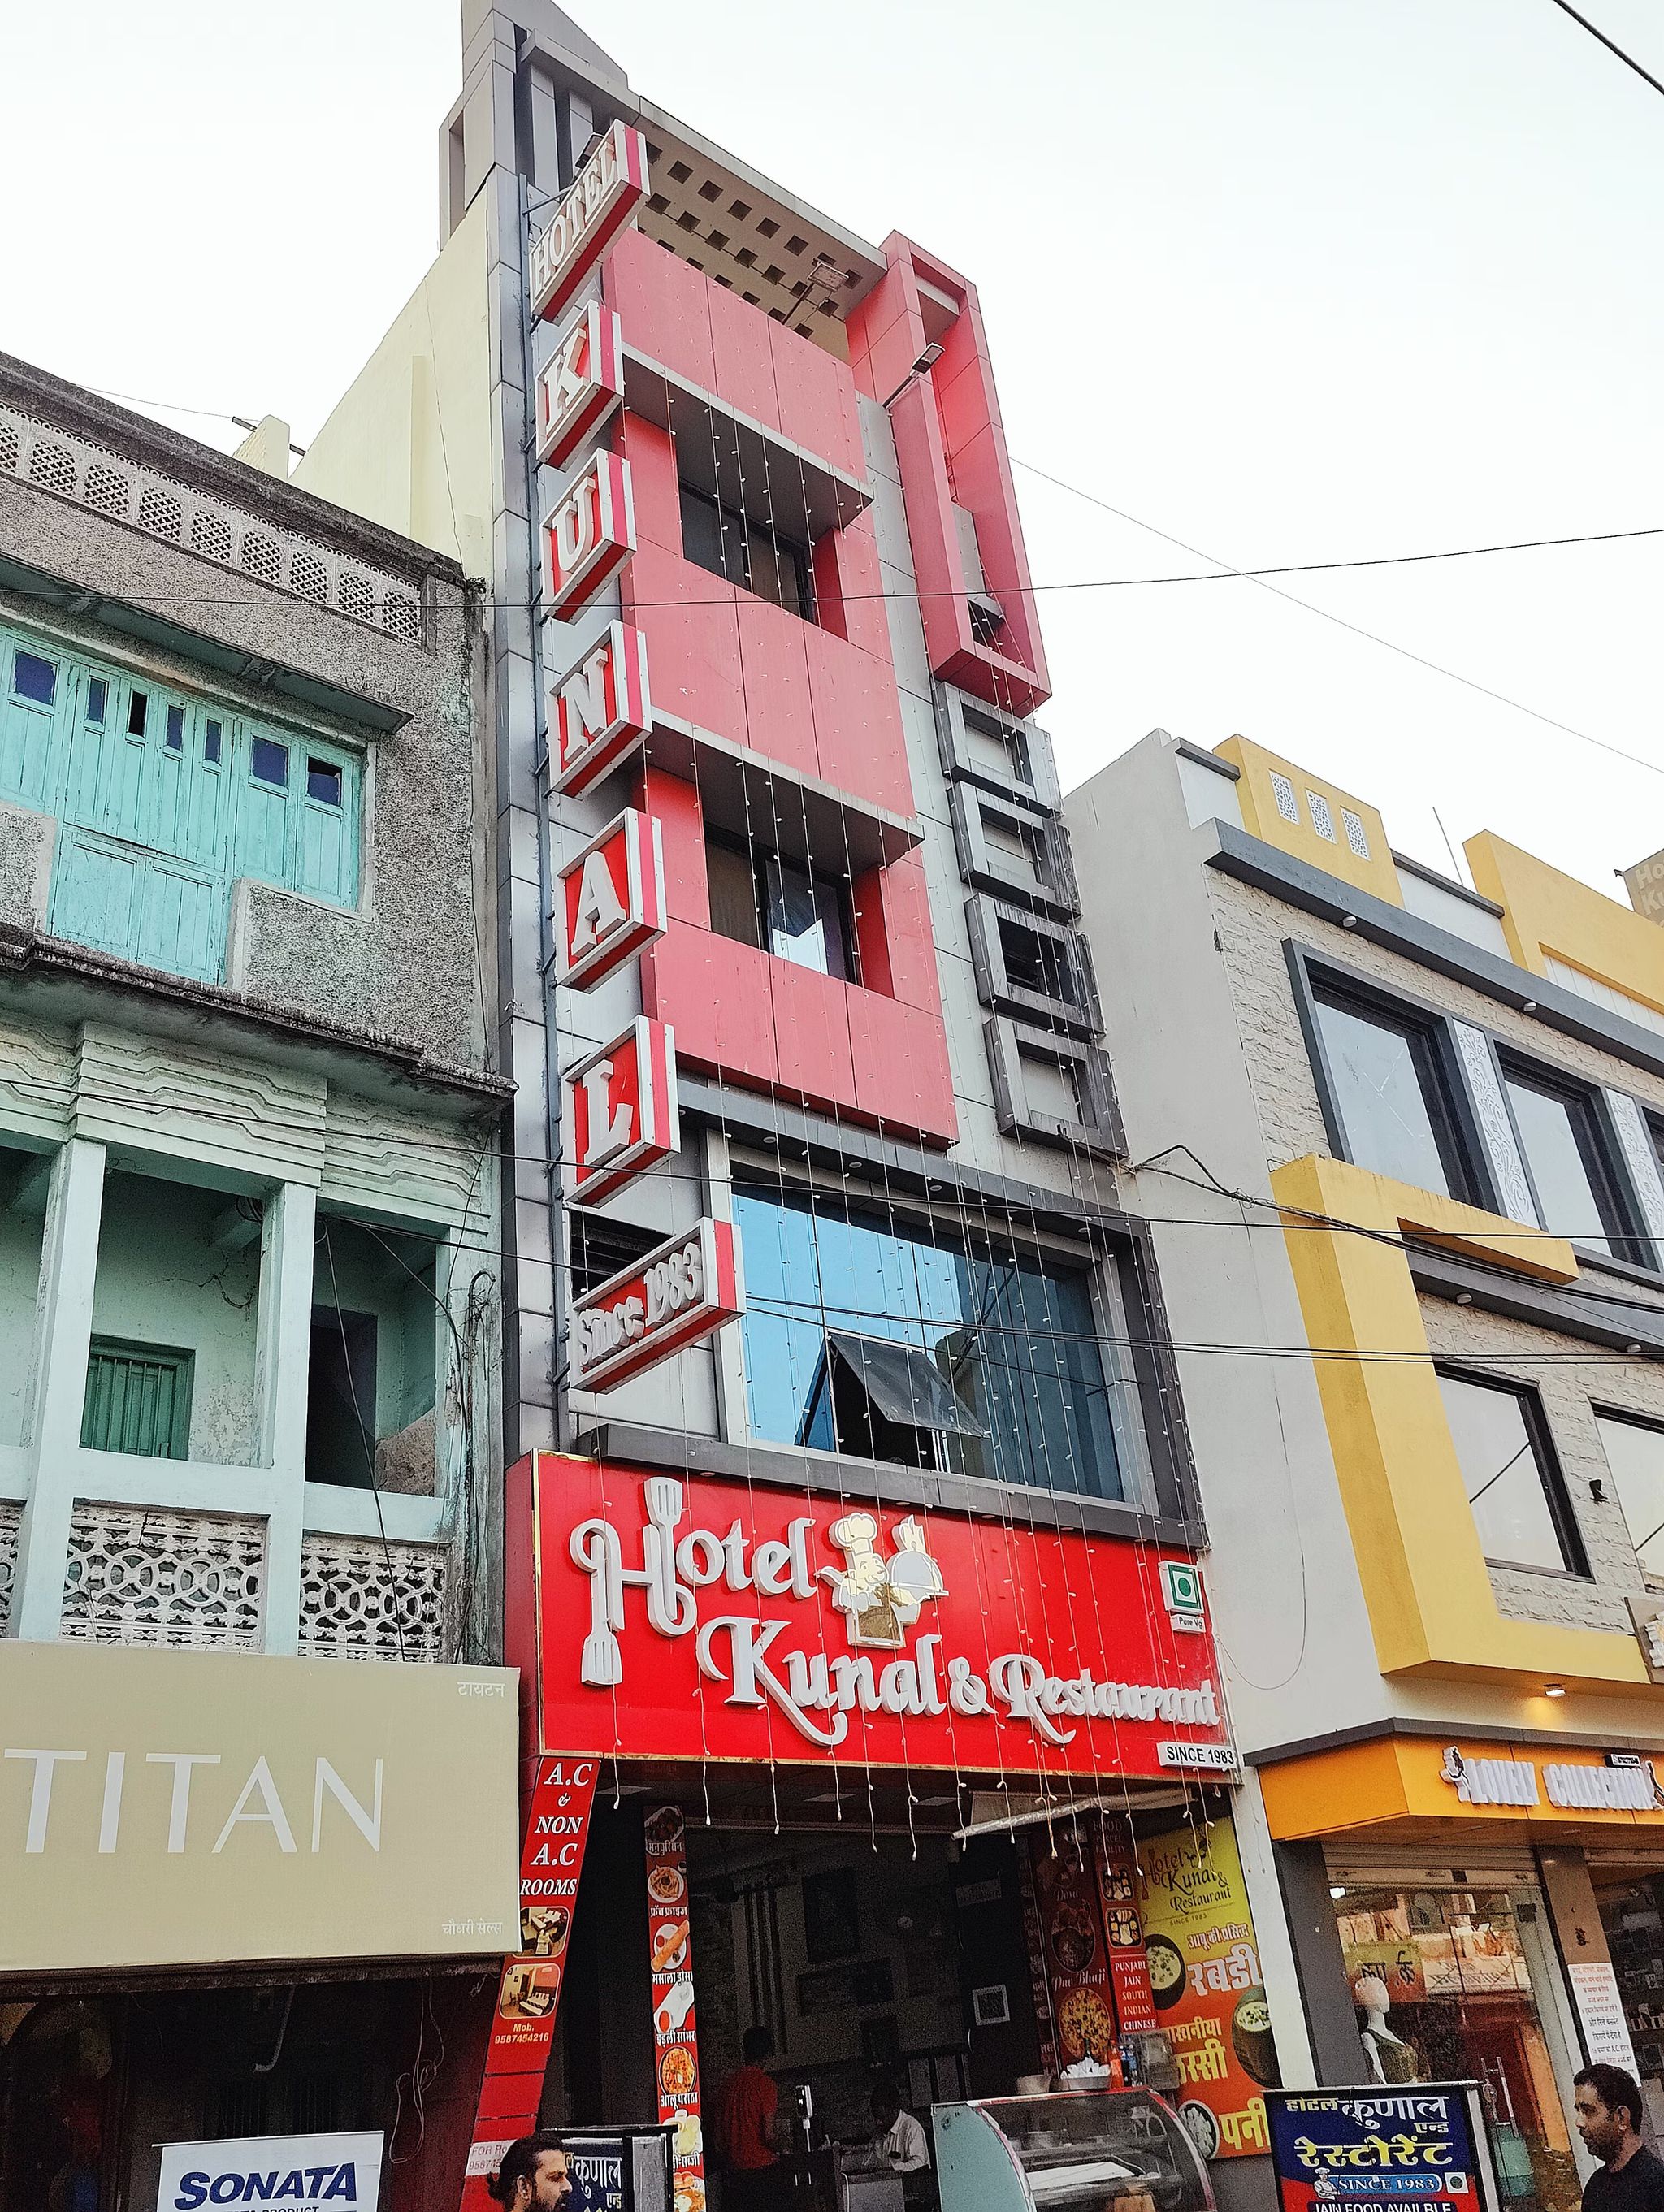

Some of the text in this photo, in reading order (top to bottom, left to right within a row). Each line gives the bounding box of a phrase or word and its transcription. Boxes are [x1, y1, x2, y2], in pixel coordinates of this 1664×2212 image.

[532, 138, 620, 299] HOTEL
[577, 1240, 704, 1368] Since 1983
[570, 1476, 818, 1686] Hotel
[1178, 1616, 1194, 1626] Pure
[456, 1682, 505, 1698] टायटन
[696, 1615, 1221, 1747] Kunal & Restaurant
[1167, 1745, 1235, 1766] SINCE 1983
[544, 1762, 592, 1786] A.C
[1542, 1763, 1654, 1811] COLLECTION
[4, 1747, 384, 1854] TITAN
[557, 1792, 571, 1807] &
[534, 1816, 584, 1834] NON
[530, 1842, 578, 1866] A.C
[520, 1878, 578, 1896] ROOMS
[1218, 1872, 1229, 1888] &
[1170, 1886, 1232, 1915] Restaurant
[442, 1917, 503, 1934] चौधरी सेल्स
[1115, 1960, 1146, 1973] PUNJABI
[1078, 1967, 1106, 1985] Bhaji
[1124, 1975, 1142, 1988] JAIN
[1122, 1990, 1147, 2001] SOUTH
[1124, 2004, 1151, 2015] INDIAN
[514, 2023, 535, 2032] Mob.
[1124, 2019, 1156, 2031] CHINESE
[495, 2032, 549, 2044] 9587454216
[1285, 2096, 1450, 2130] होटल कुणाल
[1413, 2122, 1449, 2134] एन्ड
[471, 2145, 492, 2156] FOR
[1294, 2133, 1454, 2167] रेस्टोरेंट
[174, 2162, 358, 2210] SONATA
[573, 2156, 623, 2199] कुणाल
[1339, 2177, 1436, 2190] SINCE 1983
